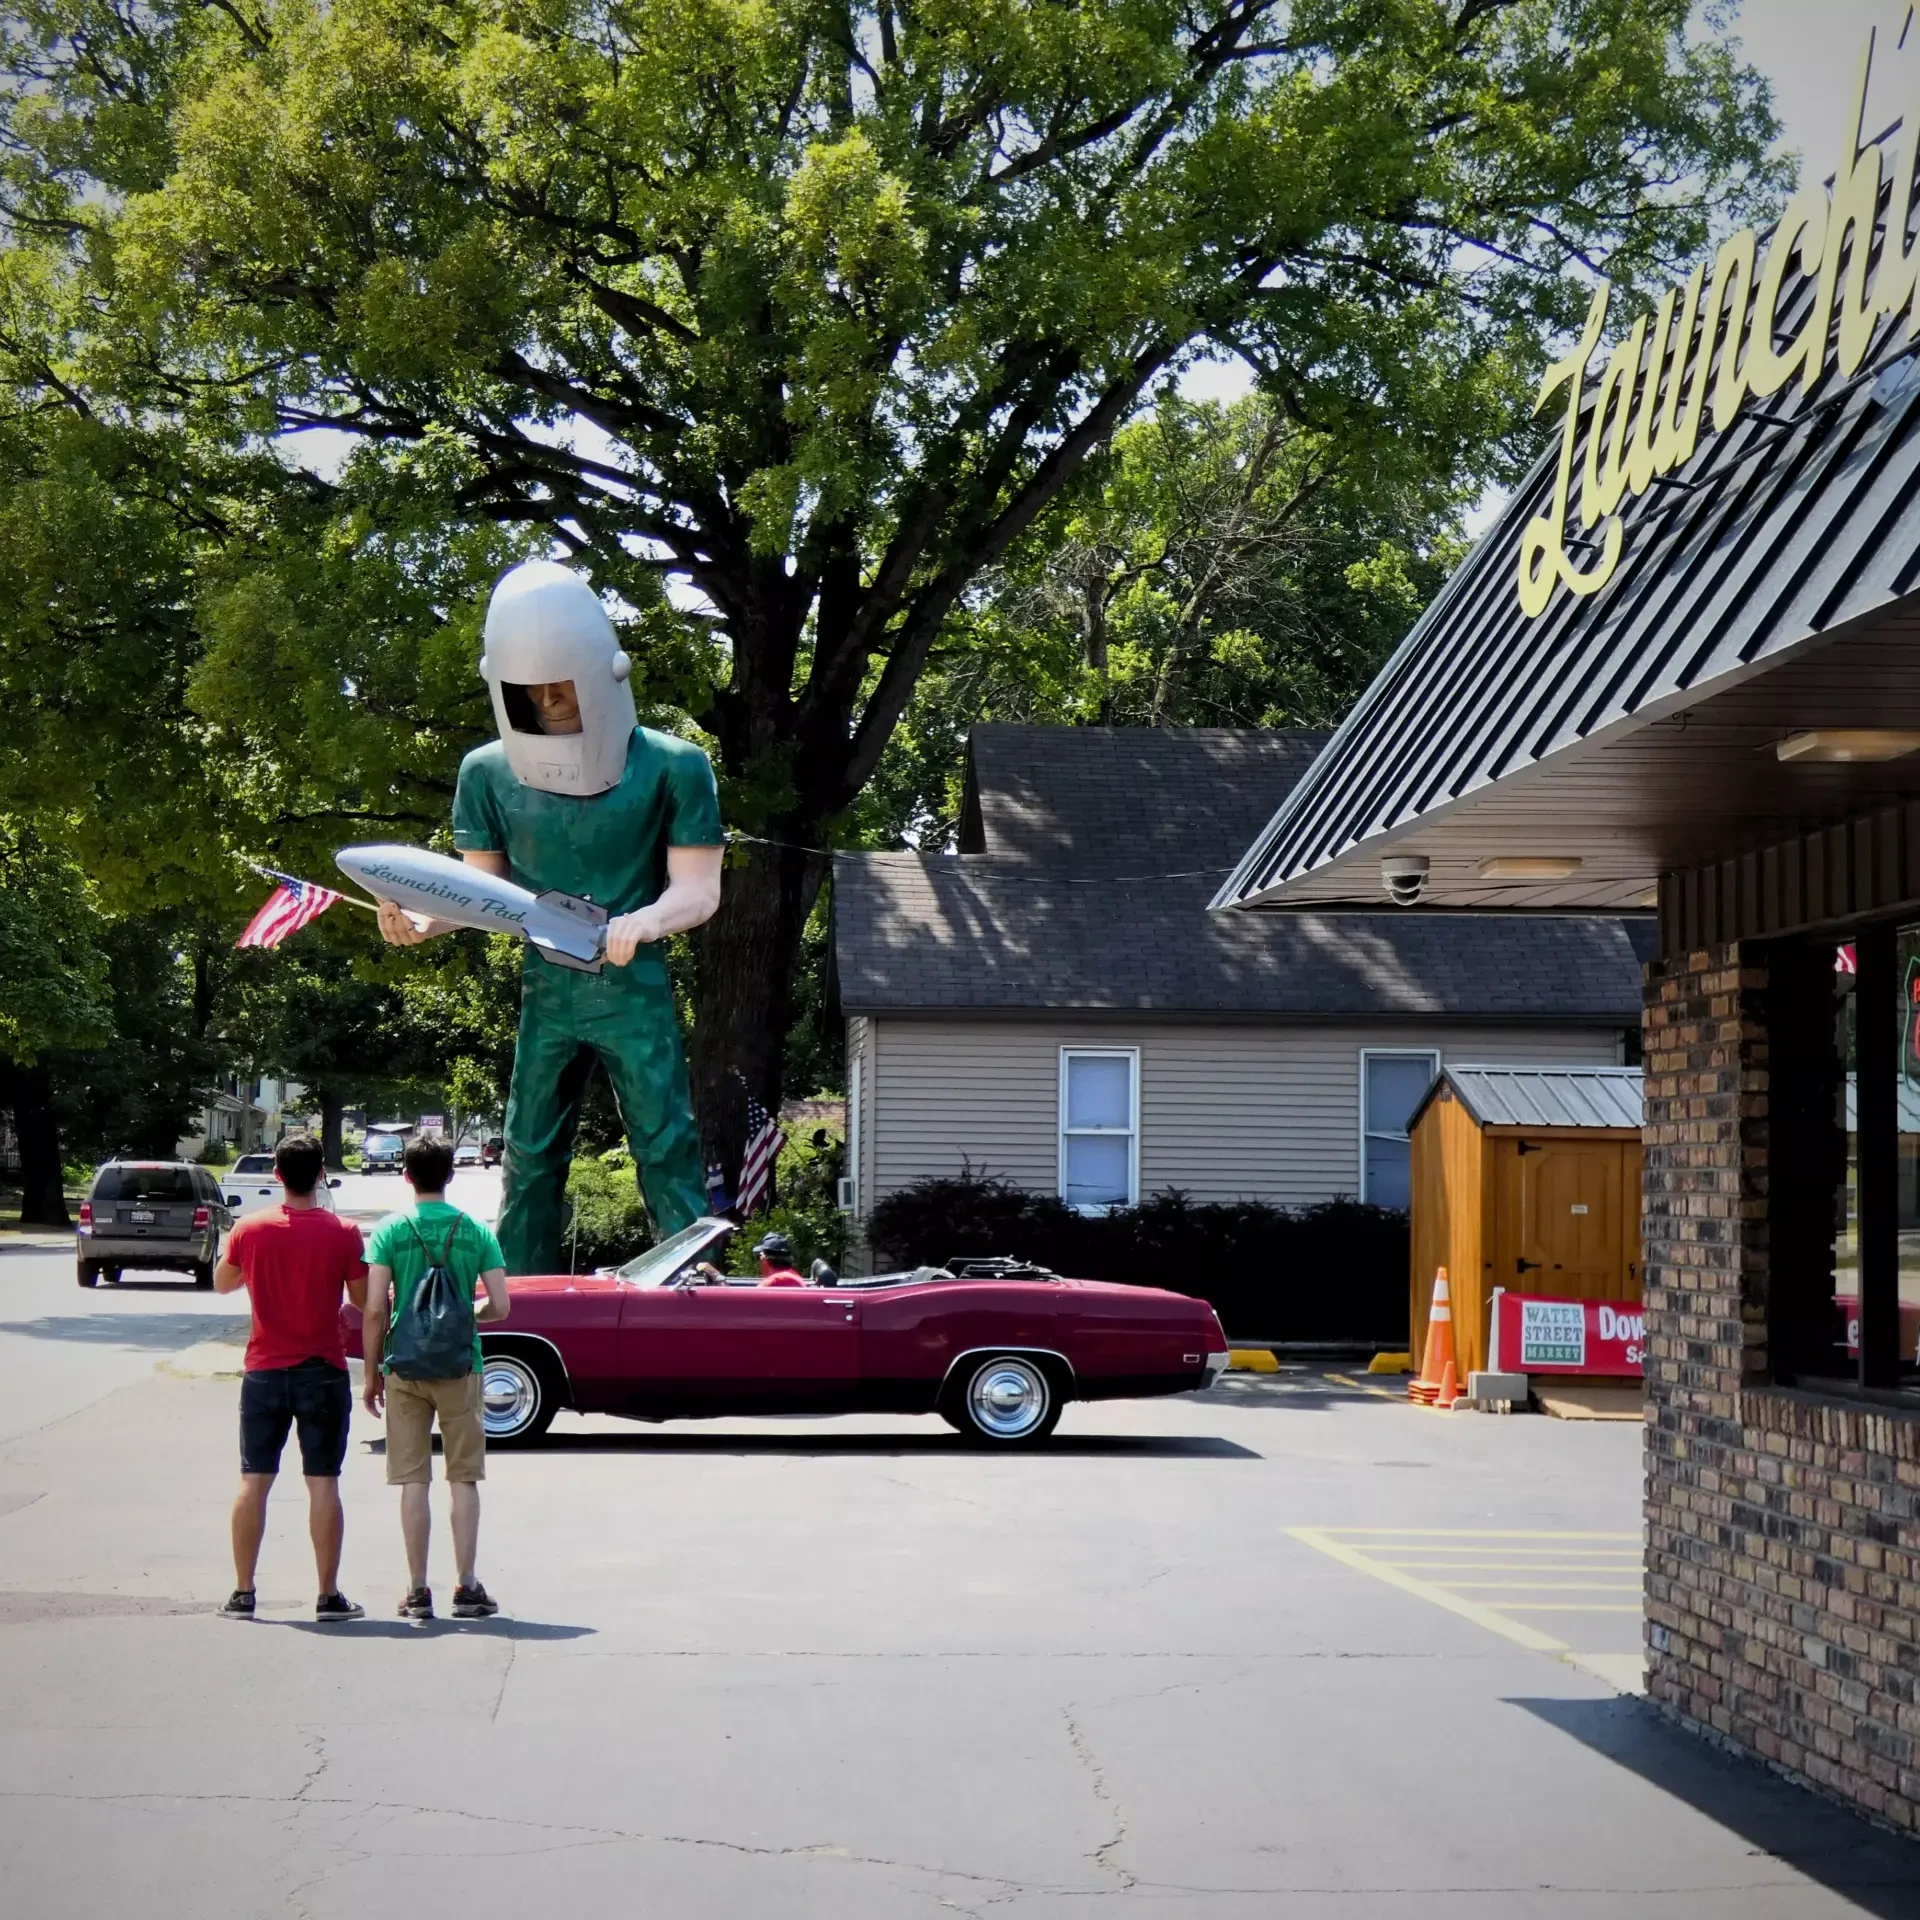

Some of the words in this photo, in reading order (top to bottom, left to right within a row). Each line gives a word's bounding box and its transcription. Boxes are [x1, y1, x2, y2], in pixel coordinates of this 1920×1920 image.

[361, 864, 473, 907] Launching
[480, 898, 527, 923] Pad
[1525, 1307, 1582, 1324] WATER
[1525, 1326, 1582, 1342] STREET
[1526, 1345, 1580, 1359] MARKET
